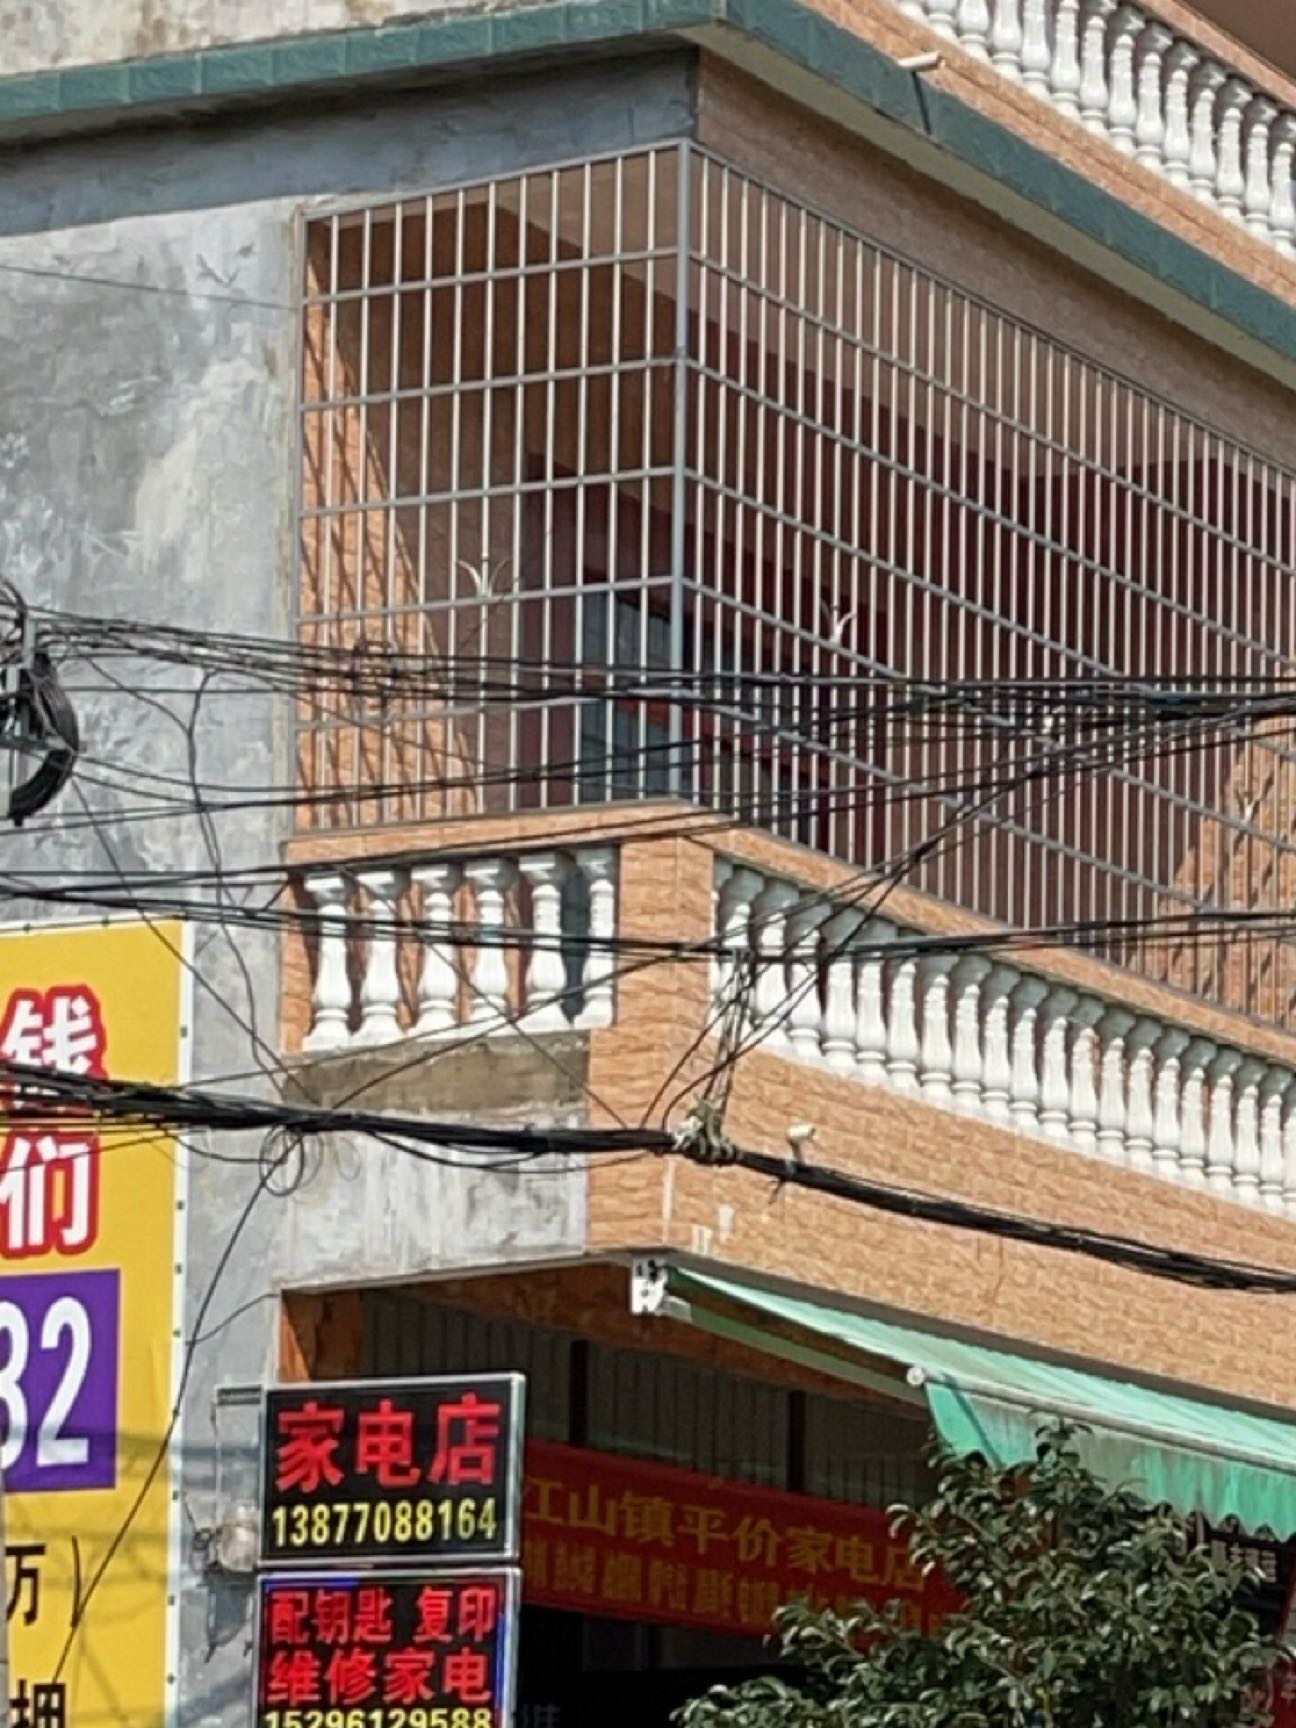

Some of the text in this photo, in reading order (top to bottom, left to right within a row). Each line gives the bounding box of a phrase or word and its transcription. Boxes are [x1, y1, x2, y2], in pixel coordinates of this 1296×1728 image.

[0, 1135, 91, 1250] 们
[275, 1391, 501, 1494] 家电店
[272, 1497, 497, 1548] 13877088164
[270, 1586, 394, 1645] 配钥匙
[413, 1585, 497, 1642] 复印
[267, 1647, 493, 1707] 维修家电
